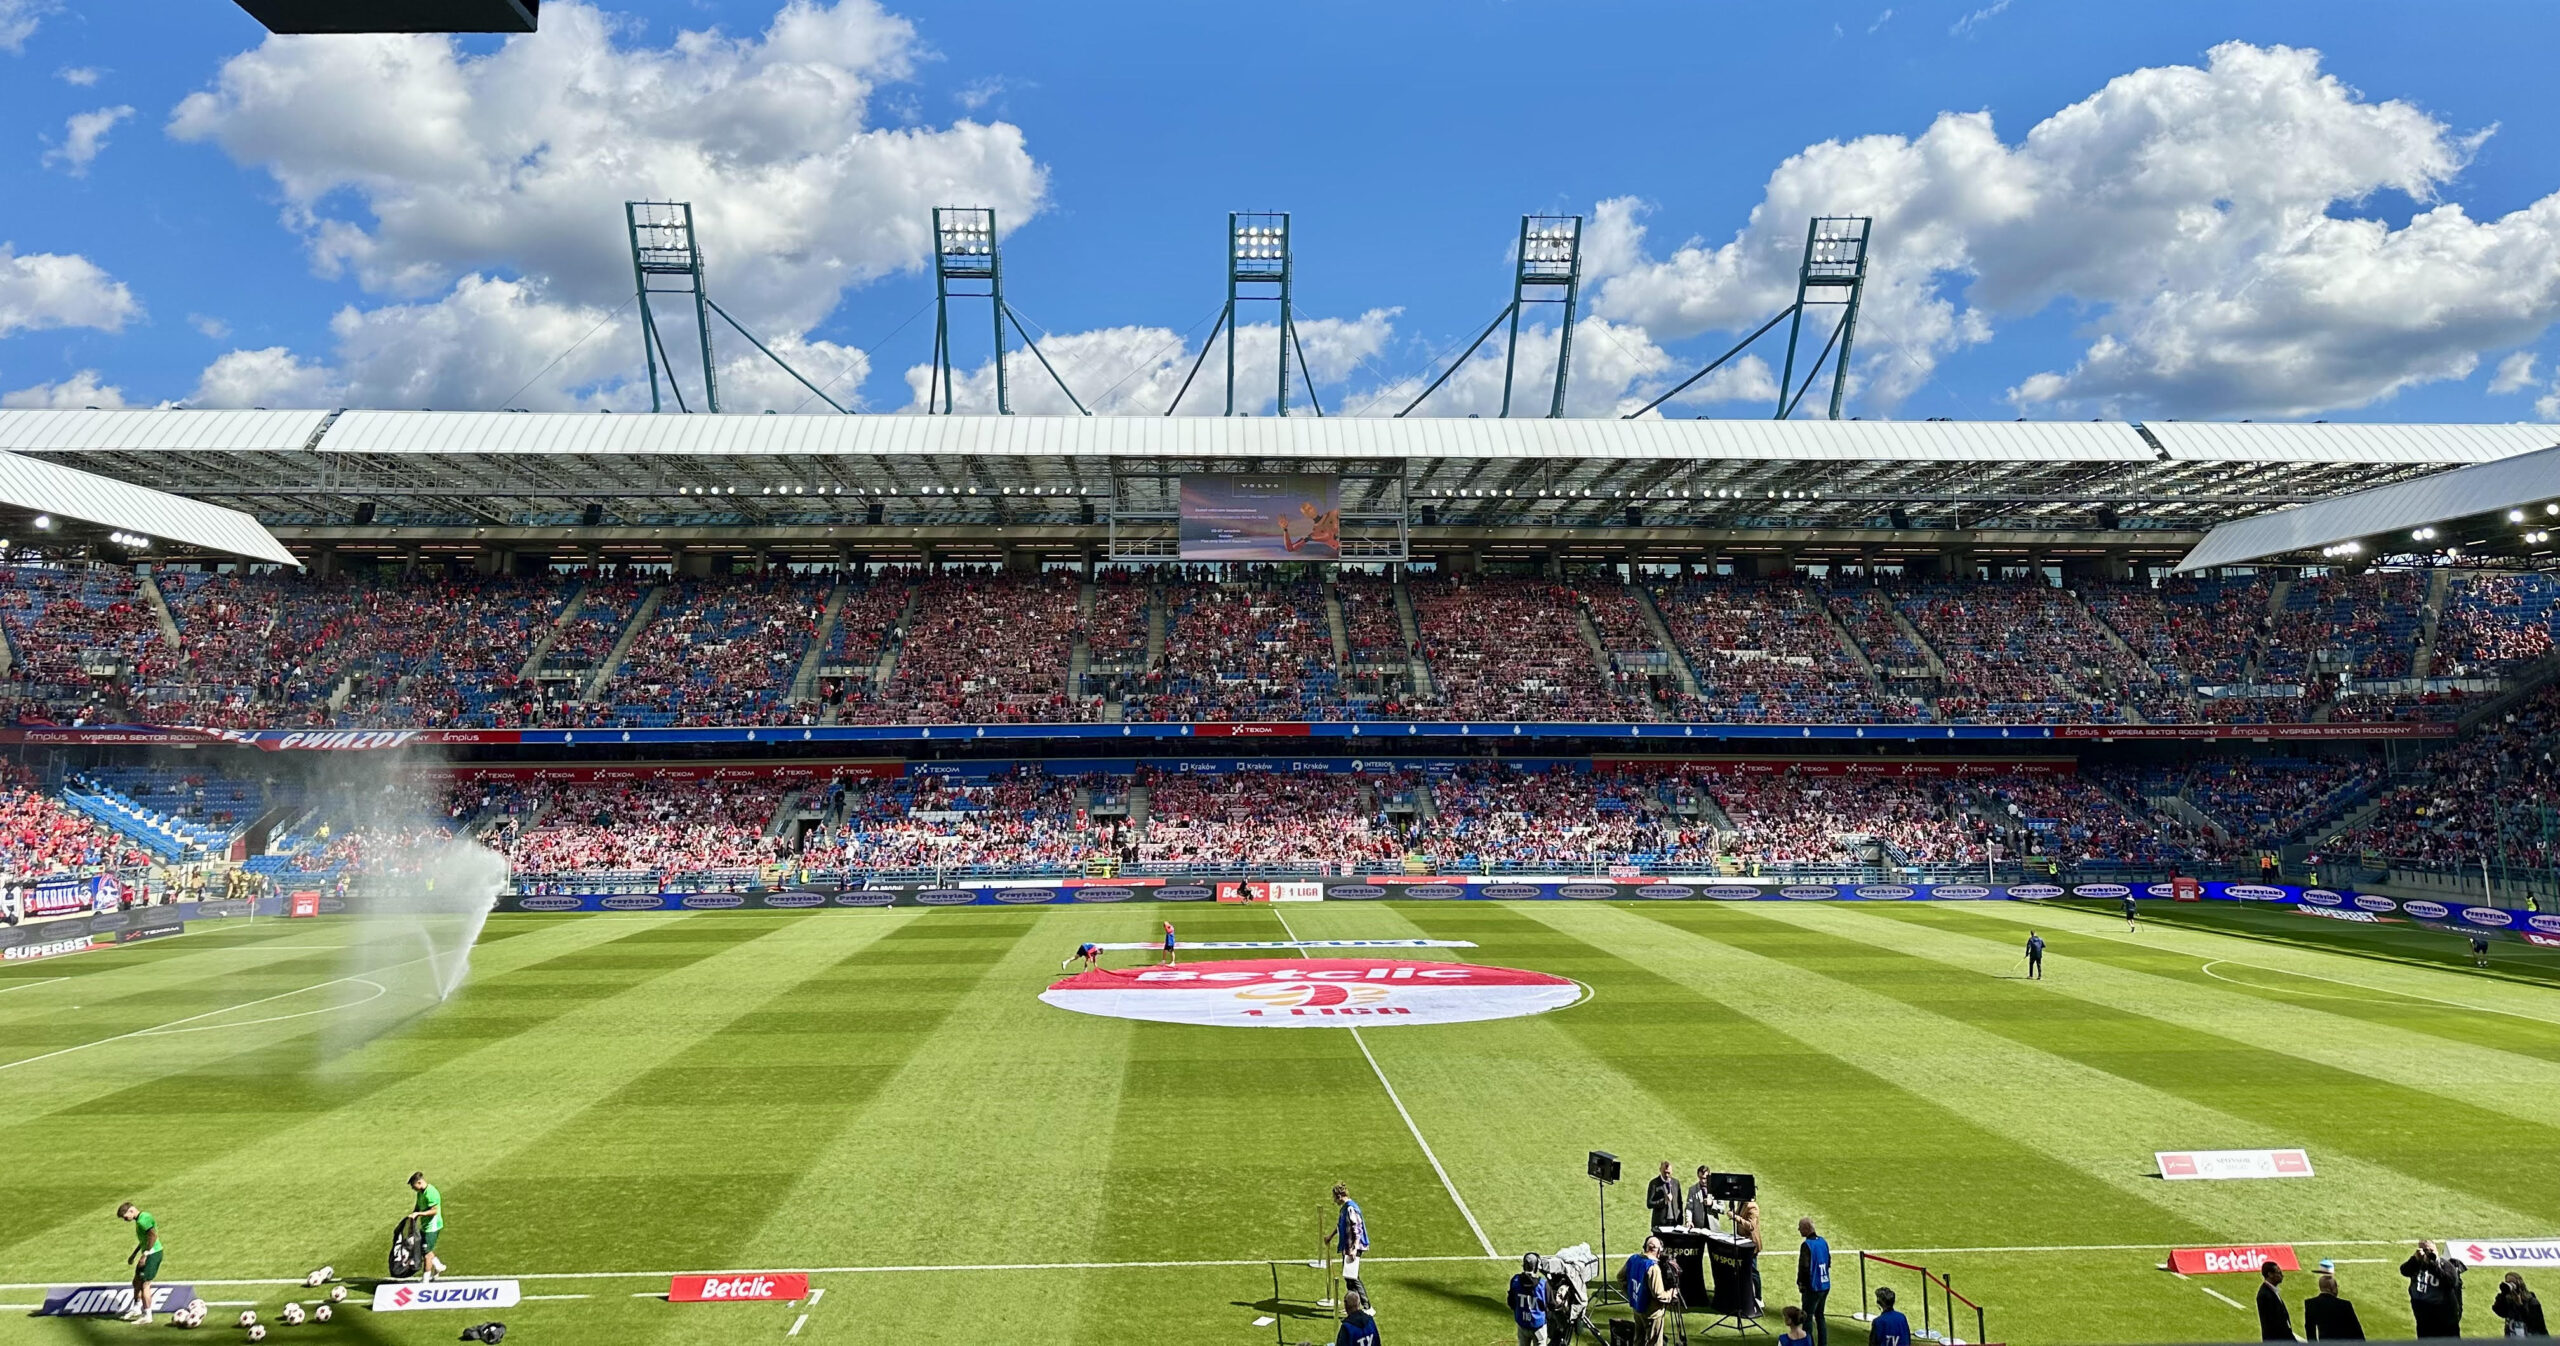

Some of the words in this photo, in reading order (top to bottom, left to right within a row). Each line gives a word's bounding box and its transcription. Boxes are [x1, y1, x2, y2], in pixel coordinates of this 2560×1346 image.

[279, 731, 416, 749] GWIAZDY
[1290, 888, 1294, 896] 1
[1298, 888, 1318, 896] LIGA
[2297, 904, 2380, 922] SUPERBET
[2444, 925, 2491, 936] TEXOM
[3, 934, 94, 960] SUPERBET
[1134, 967, 1472, 982] Betclic
[1290, 1007, 1411, 1016] LIGA
[2204, 1252, 2268, 1272] Betclic
[417, 1286, 499, 1303] SUZUKI
[701, 1276, 776, 1298] Betclic
[64, 1287, 174, 1313] 4MOE
[1517, 1293, 1538, 1310] TV
